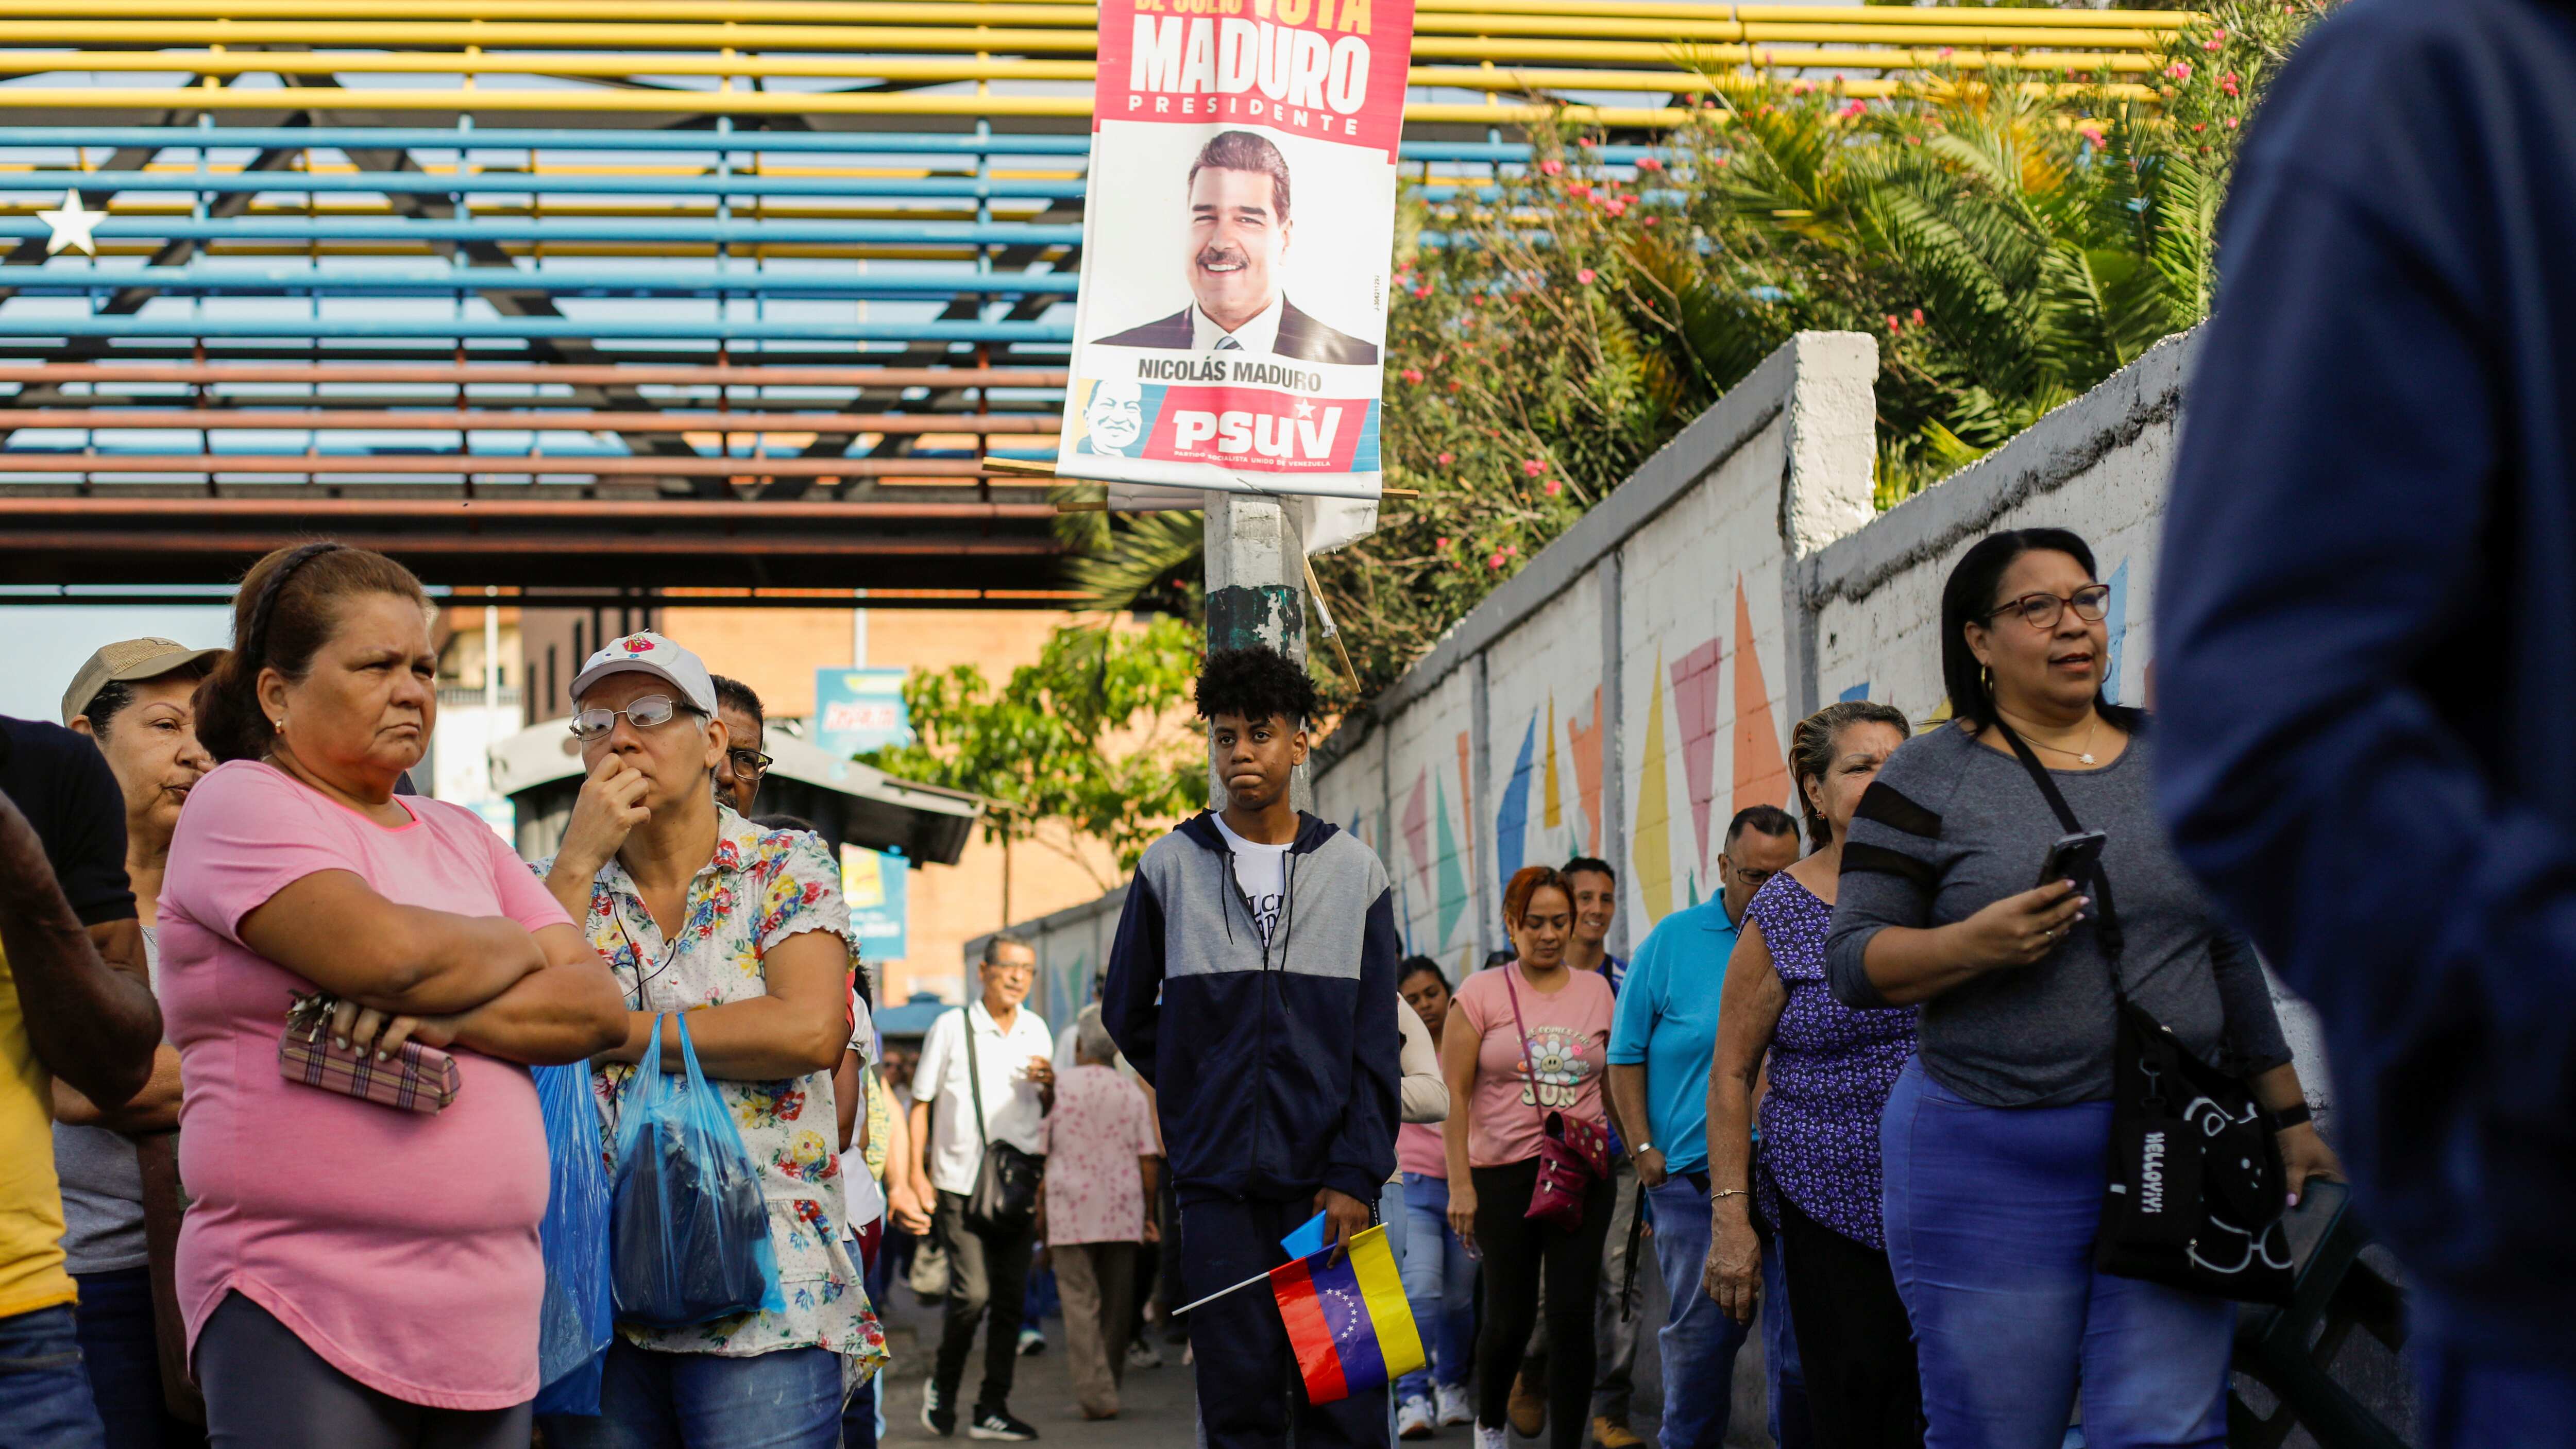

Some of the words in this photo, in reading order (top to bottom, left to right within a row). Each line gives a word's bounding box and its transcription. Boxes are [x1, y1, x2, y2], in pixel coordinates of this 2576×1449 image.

[1130, 14, 1371, 115] MADURO
[1128, 95, 1358, 135] PRESIDENTE
[1137, 355, 1226, 382] NICOLÁS
[1232, 361, 1322, 393] MADURO
[1207, 454, 1248, 463] SOCIALISTA
[1250, 457, 1275, 465] UNIDO
